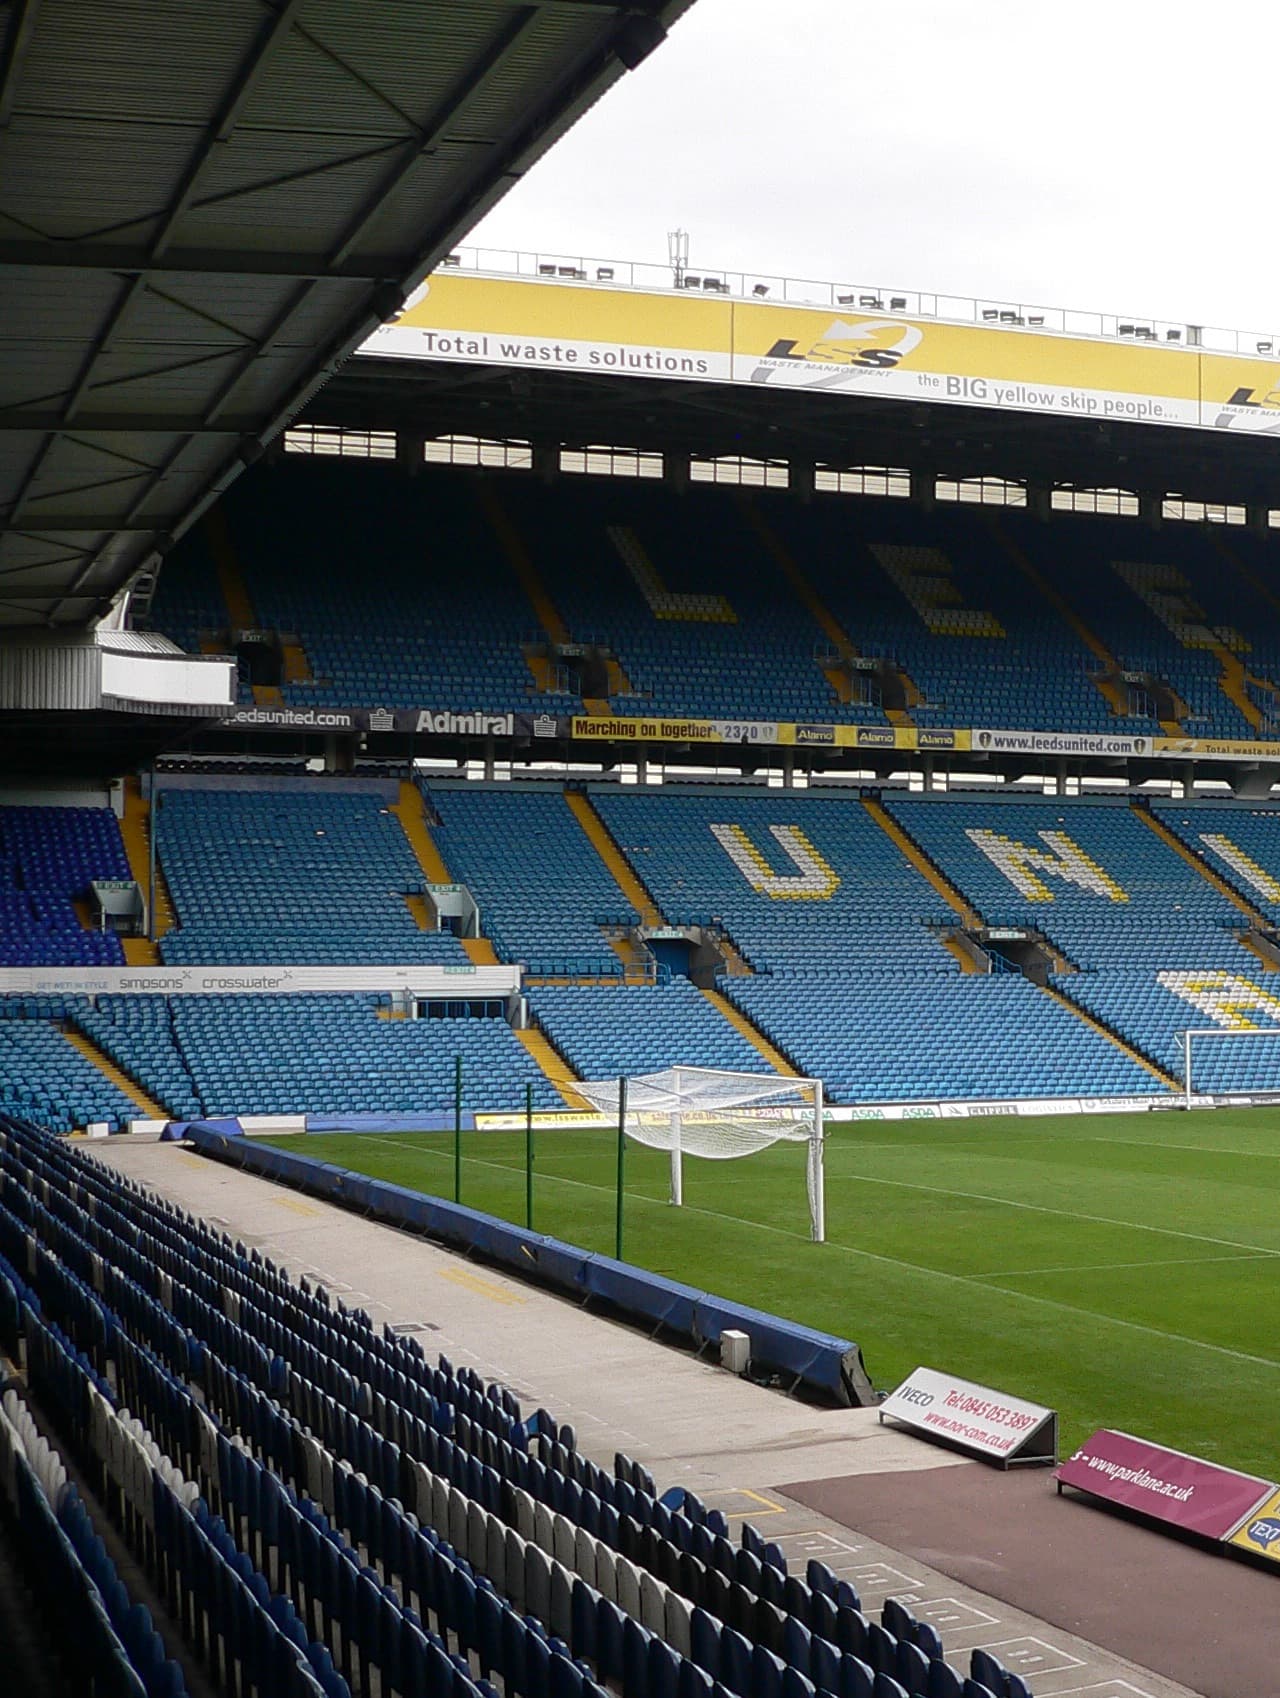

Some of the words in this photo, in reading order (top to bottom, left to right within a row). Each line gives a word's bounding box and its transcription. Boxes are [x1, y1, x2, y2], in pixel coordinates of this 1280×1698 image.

[422, 332, 488, 355] Total
[500, 342, 577, 363] waste
[589, 348, 708, 373] solutions
[759, 358, 803, 369] WASTE
[805, 363, 893, 378] MANAGEMENT
[917, 373, 940, 388] the
[946, 375, 988, 399] BIG
[994, 385, 1055, 407] yellow
[1061, 391, 1098, 413] skip
[1103, 397, 1178, 419] people...
[1221, 405, 1258, 415] WASTE
[416, 710, 514, 735] Admiral
[575, 720, 636, 737] Marching
[641, 725, 656, 737] on
[661, 721, 712, 739] together
[798, 729, 833, 741] Alamo
[859, 729, 894, 742] Alamo
[920, 734, 953, 745] Alamo
[994, 735, 1132, 753] www.leedsunited.com
[1205, 744, 1231, 754] Total
[1233, 747, 1263, 757] waste
[120, 977, 183, 990] simpsons
[202, 976, 283, 989] crosswater
[852, 1109, 885, 1119] ASDA
[902, 1108, 935, 1118] ASDA
[897, 1385, 935, 1407] IVECO
[985, 1405, 1011, 1423] 053
[1004, 1411, 1039, 1431] 3897
[923, 1411, 1017, 1451] www.nor-com.co.uk
[1088, 1455, 1194, 1503] www.parklane.ac.uk
